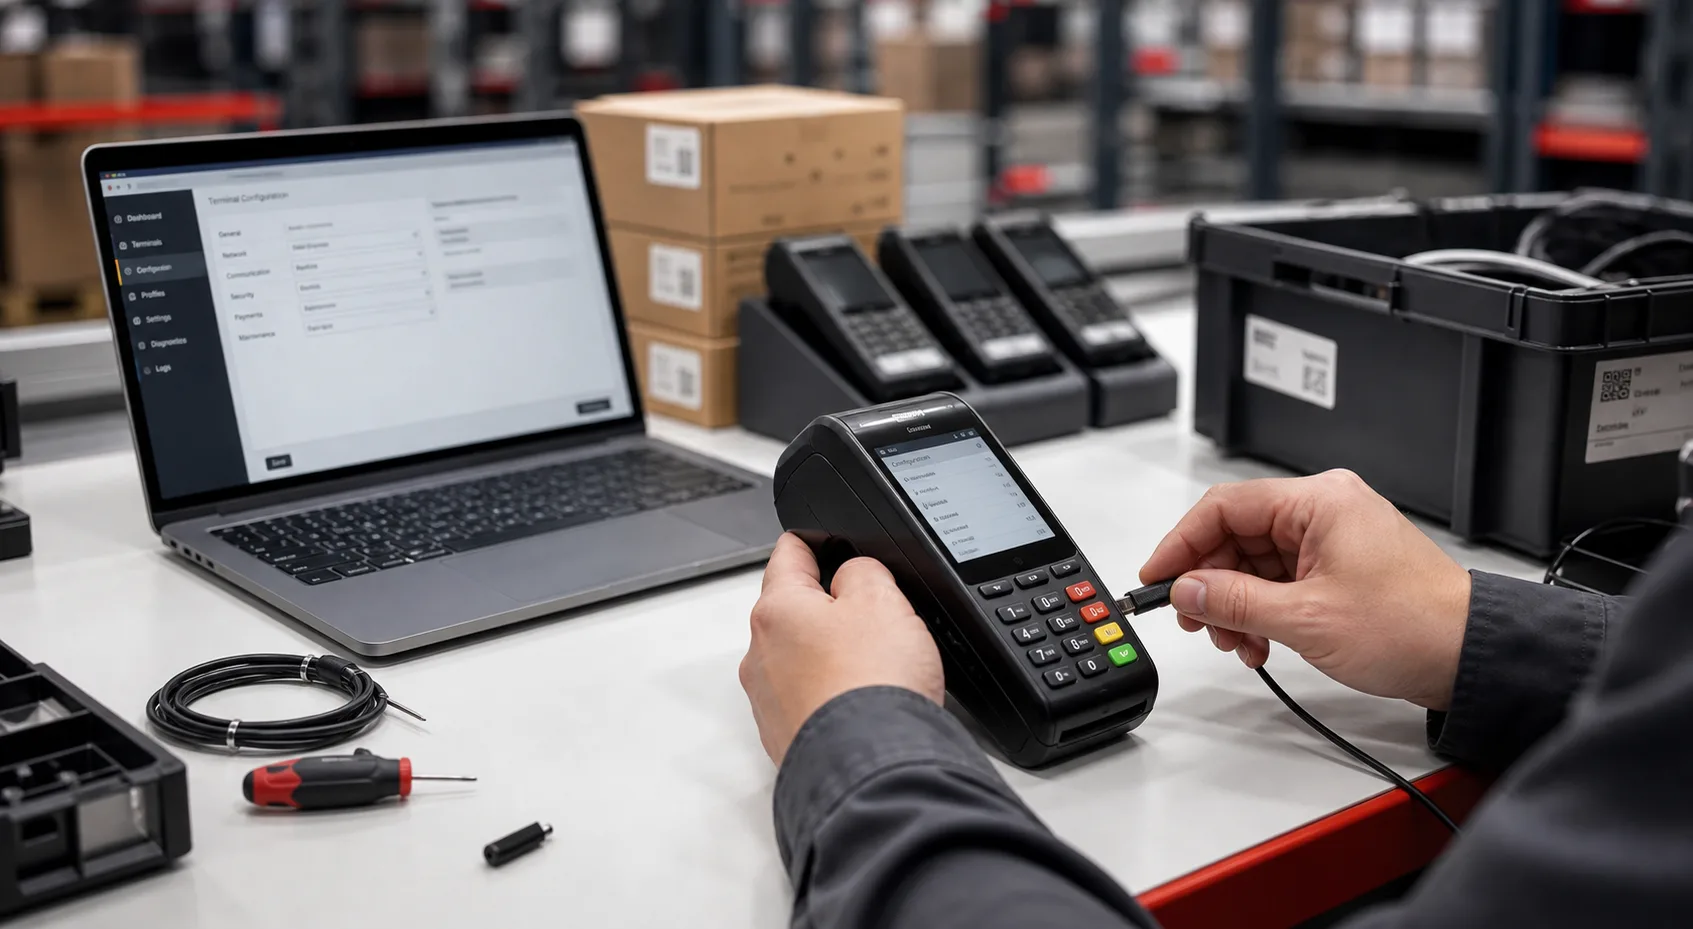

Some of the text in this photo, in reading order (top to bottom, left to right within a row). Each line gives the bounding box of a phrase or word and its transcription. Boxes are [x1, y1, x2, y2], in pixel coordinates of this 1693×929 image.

[208, 195, 240, 205] Terminal
[127, 211, 162, 222] Dashboard
[218, 230, 241, 238] General
[131, 238, 163, 249] Terminals
[146, 313, 172, 324] Settings
[155, 363, 171, 373] Logs
[1007, 607, 1017, 618] 1
[1022, 628, 1031, 639] 4
[1035, 649, 1046, 661] 7
[1087, 660, 1097, 671] 0
